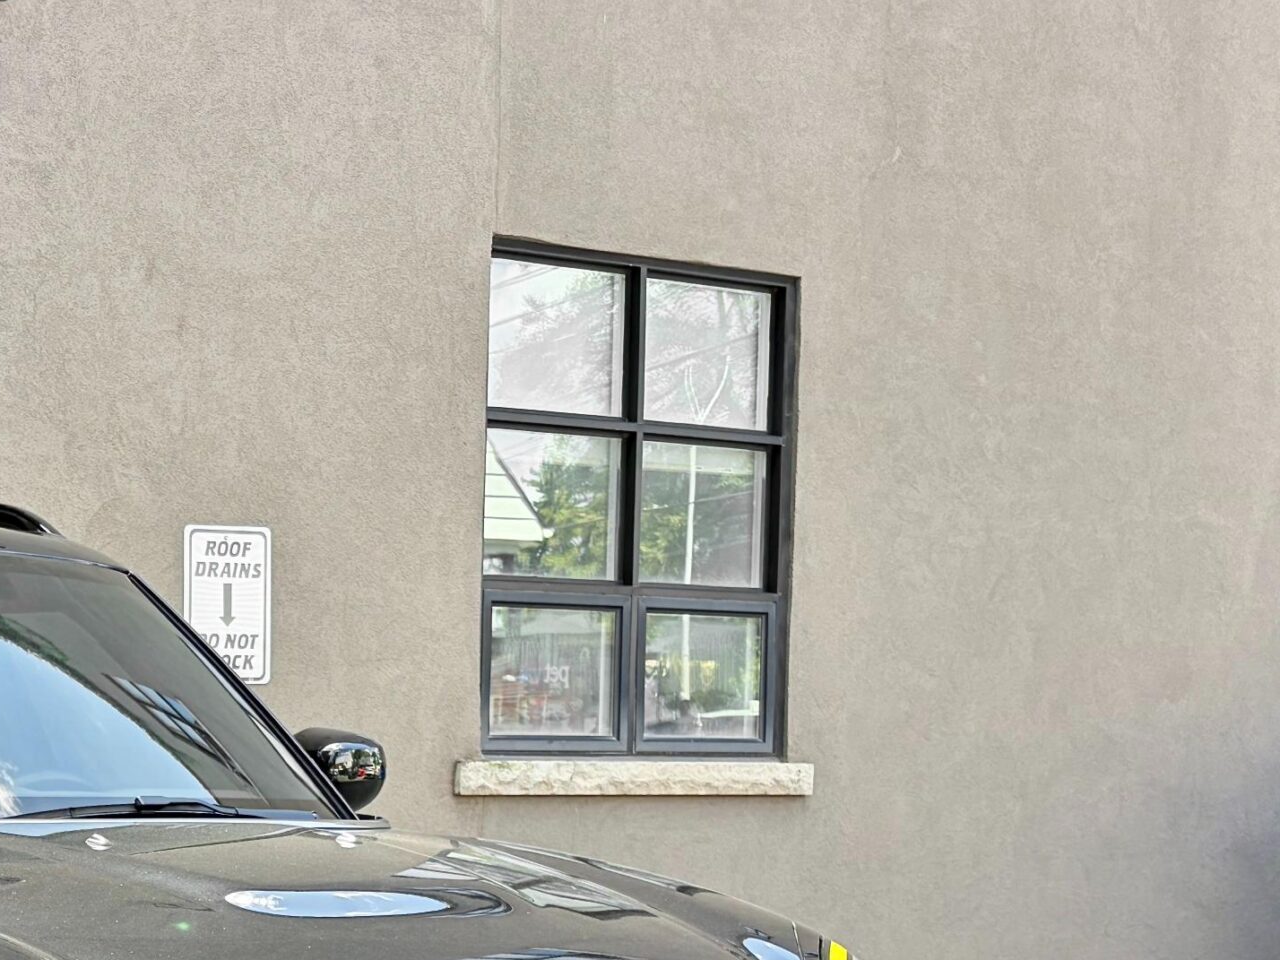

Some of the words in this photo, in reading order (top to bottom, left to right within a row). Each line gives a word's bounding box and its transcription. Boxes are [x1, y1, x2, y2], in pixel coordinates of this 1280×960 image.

[204, 541, 252, 557] ROOF
[194, 561, 262, 579] DRAINS
[224, 633, 259, 650] NOT
